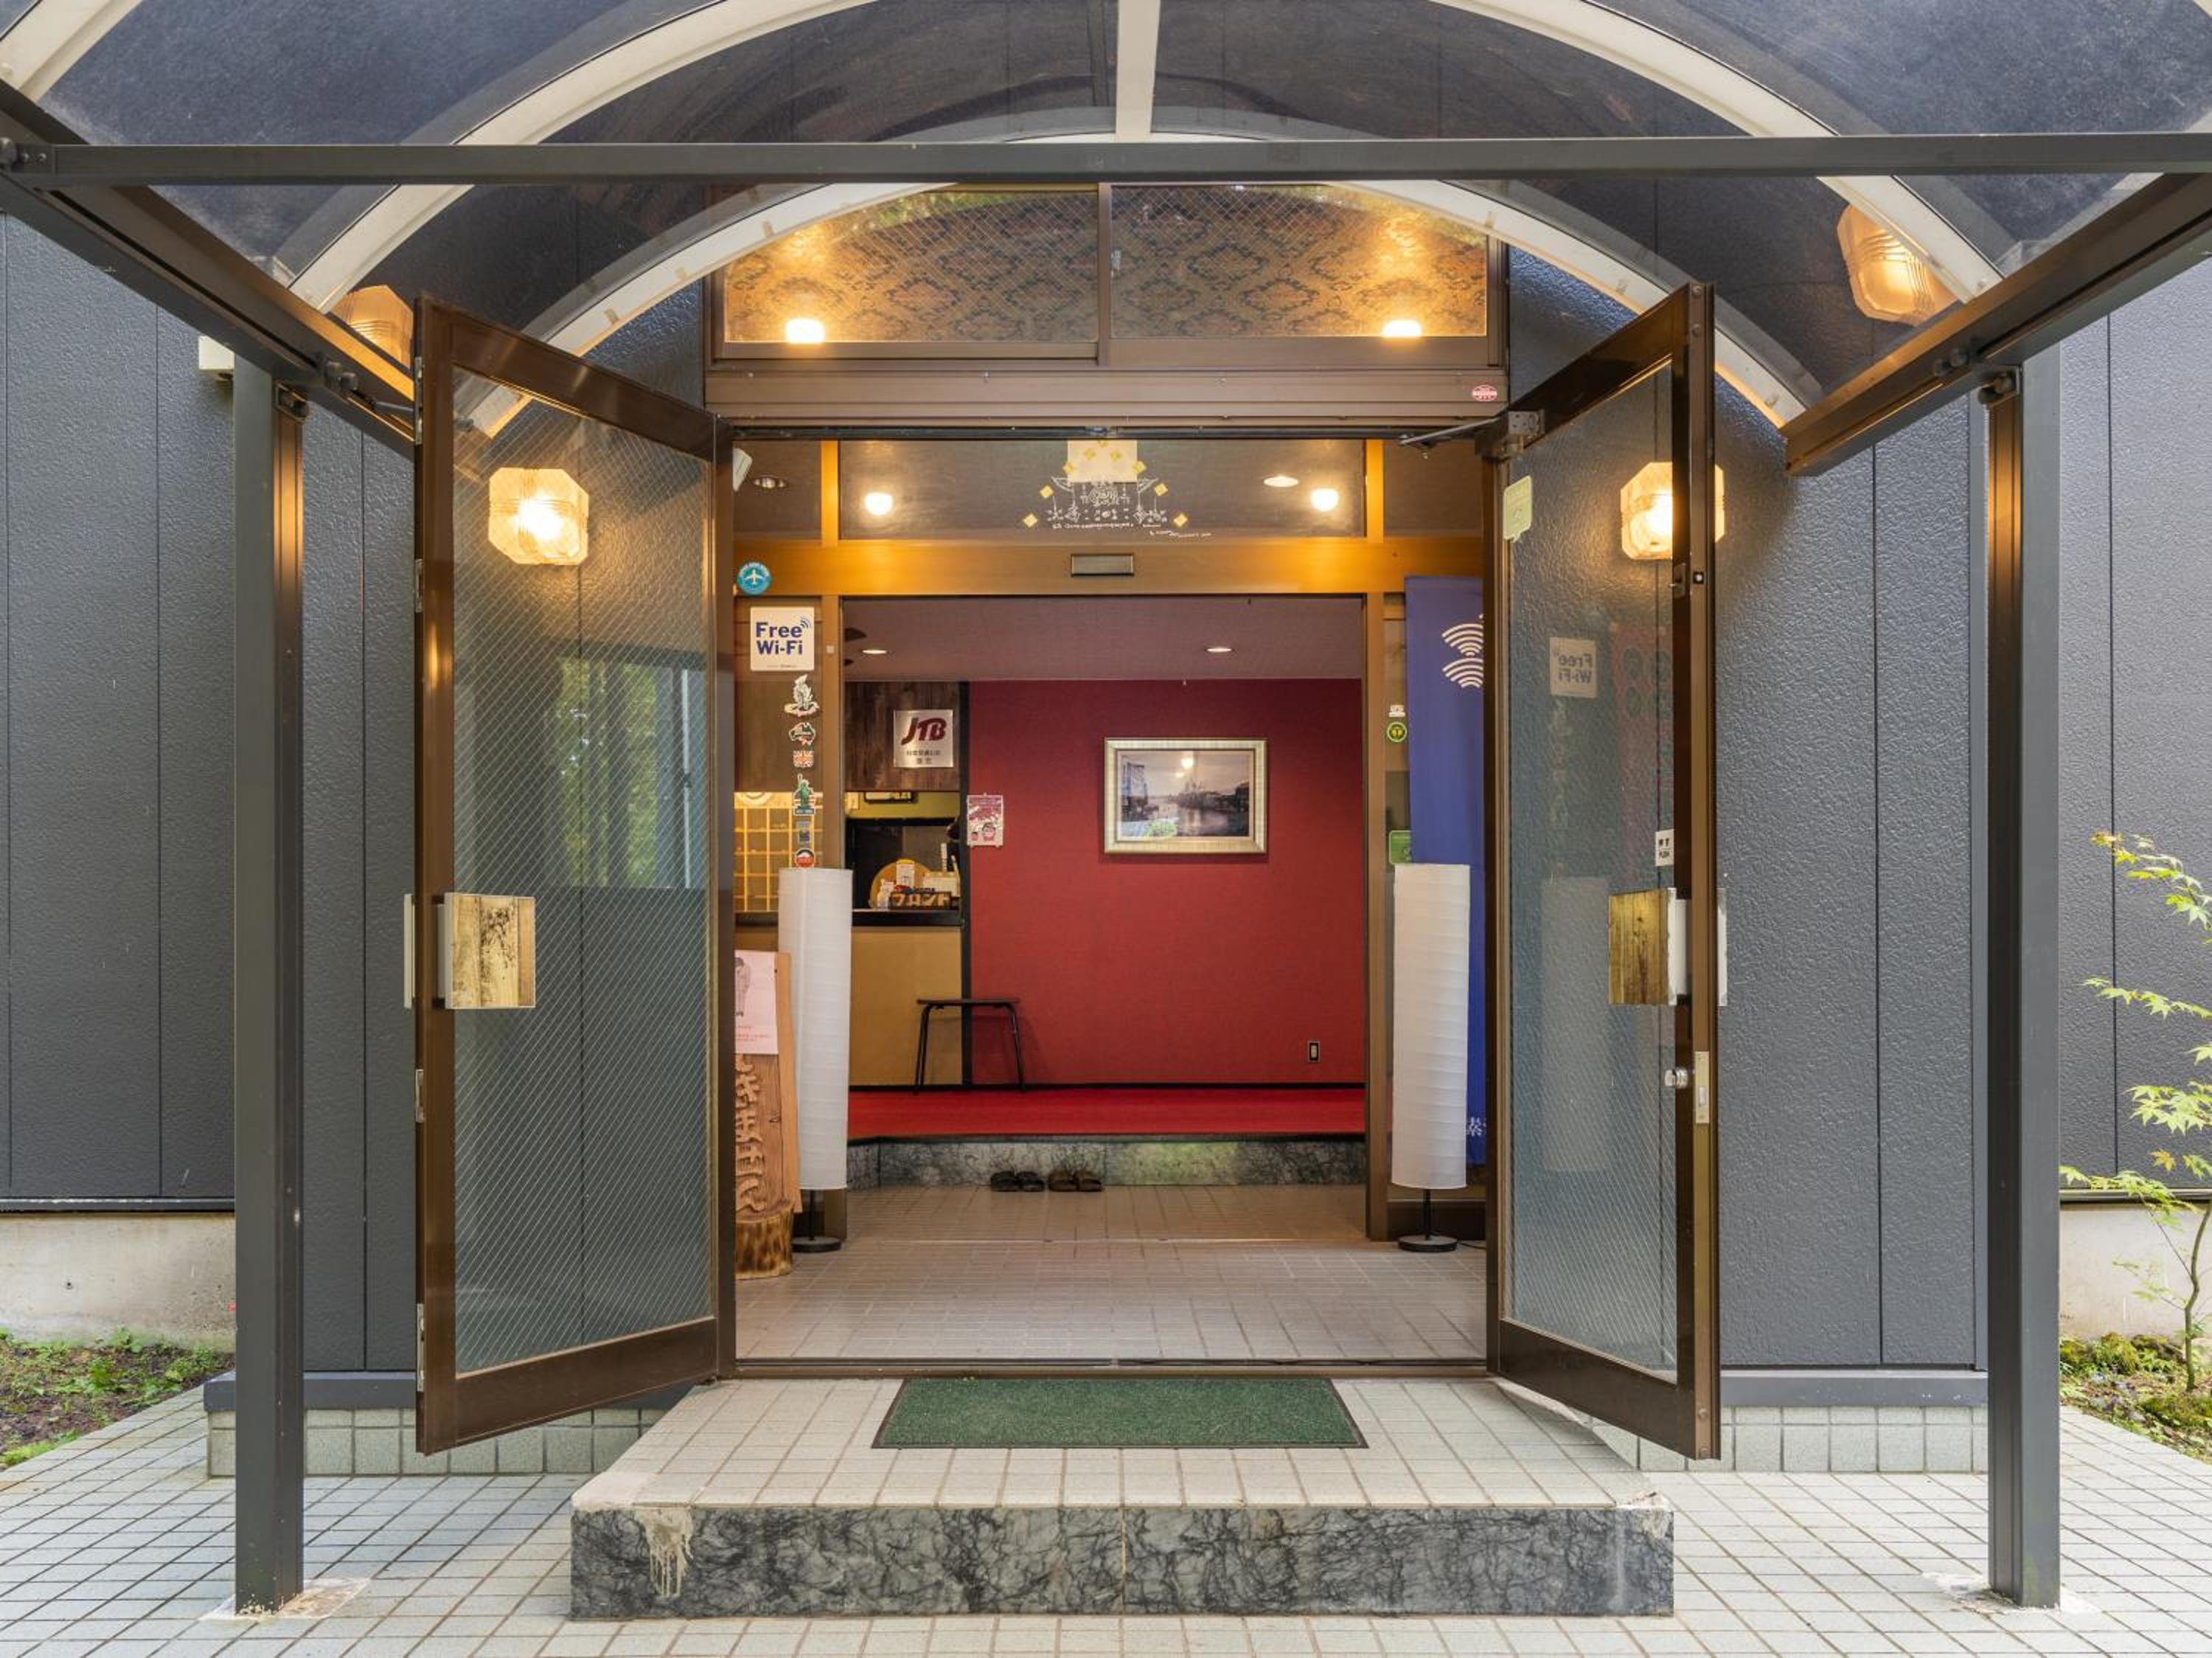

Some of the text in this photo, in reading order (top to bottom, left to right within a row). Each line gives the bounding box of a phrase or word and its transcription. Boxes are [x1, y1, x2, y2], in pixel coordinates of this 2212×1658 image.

[756, 622, 803, 638] Free
[756, 640, 803, 655] Wi-Fi
[900, 717, 947, 746] JTB
[892, 893, 950, 907] フロント
